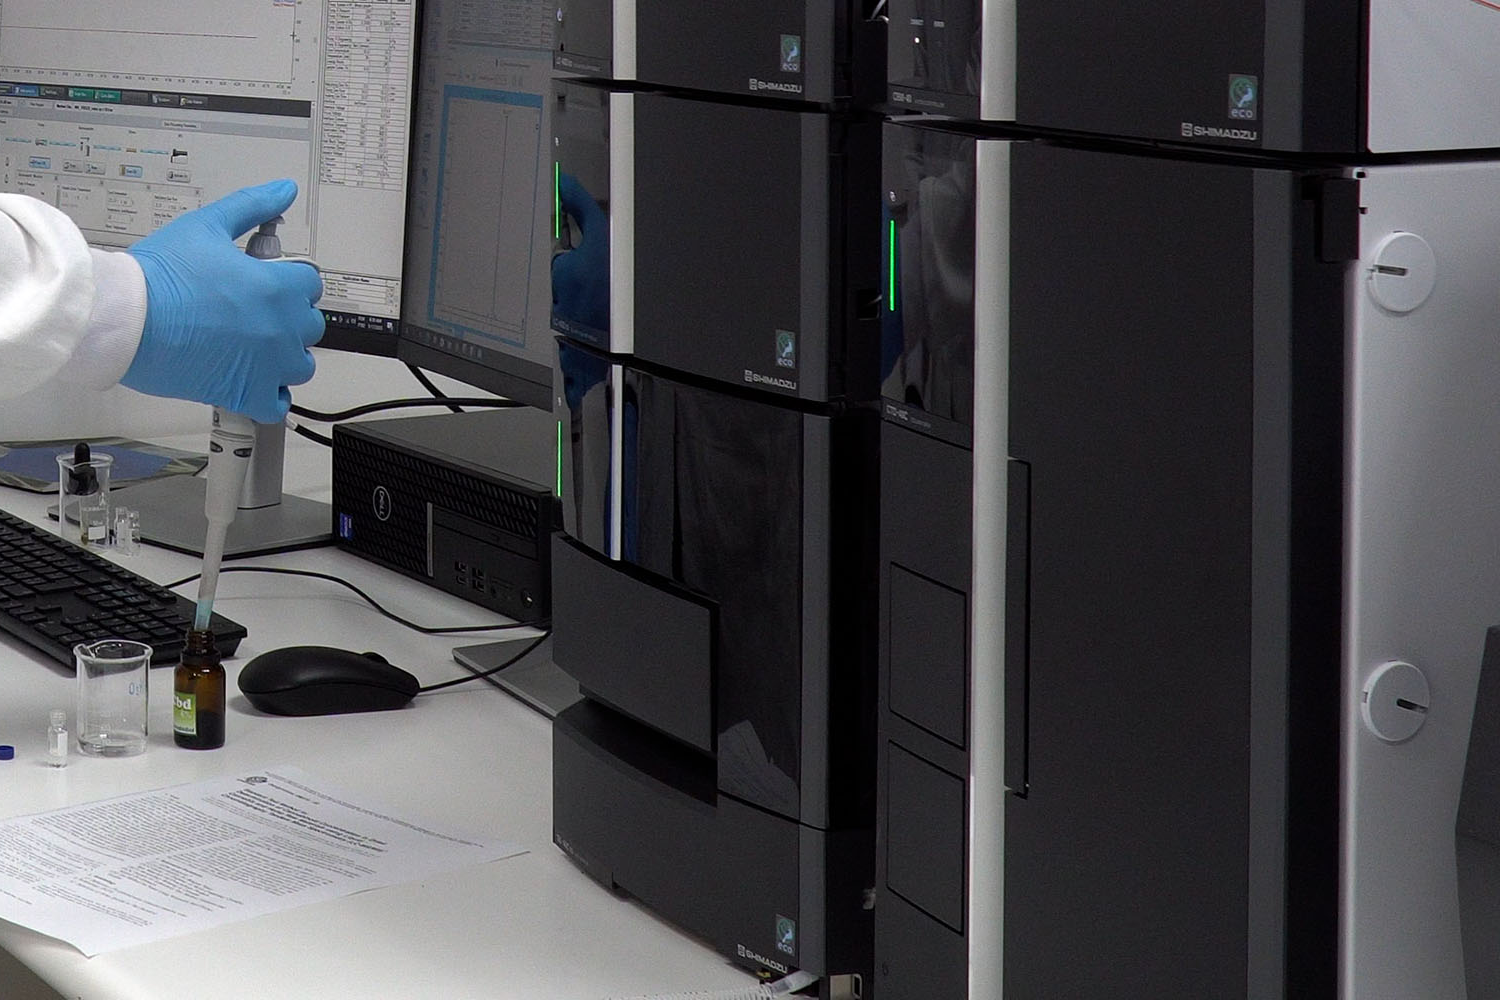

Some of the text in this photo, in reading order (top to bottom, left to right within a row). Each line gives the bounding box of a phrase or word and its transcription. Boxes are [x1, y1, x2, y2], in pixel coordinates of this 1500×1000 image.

[757, 80, 803, 94] SHIMADZU
[1231, 108, 1254, 118] eco
[1193, 125, 1257, 141] SHIMADZU
[777, 357, 793, 367] eco
[752, 373, 797, 390] SHIMADZU
[777, 942, 793, 954] eco
[745, 948, 789, 975] SHIMADZU
